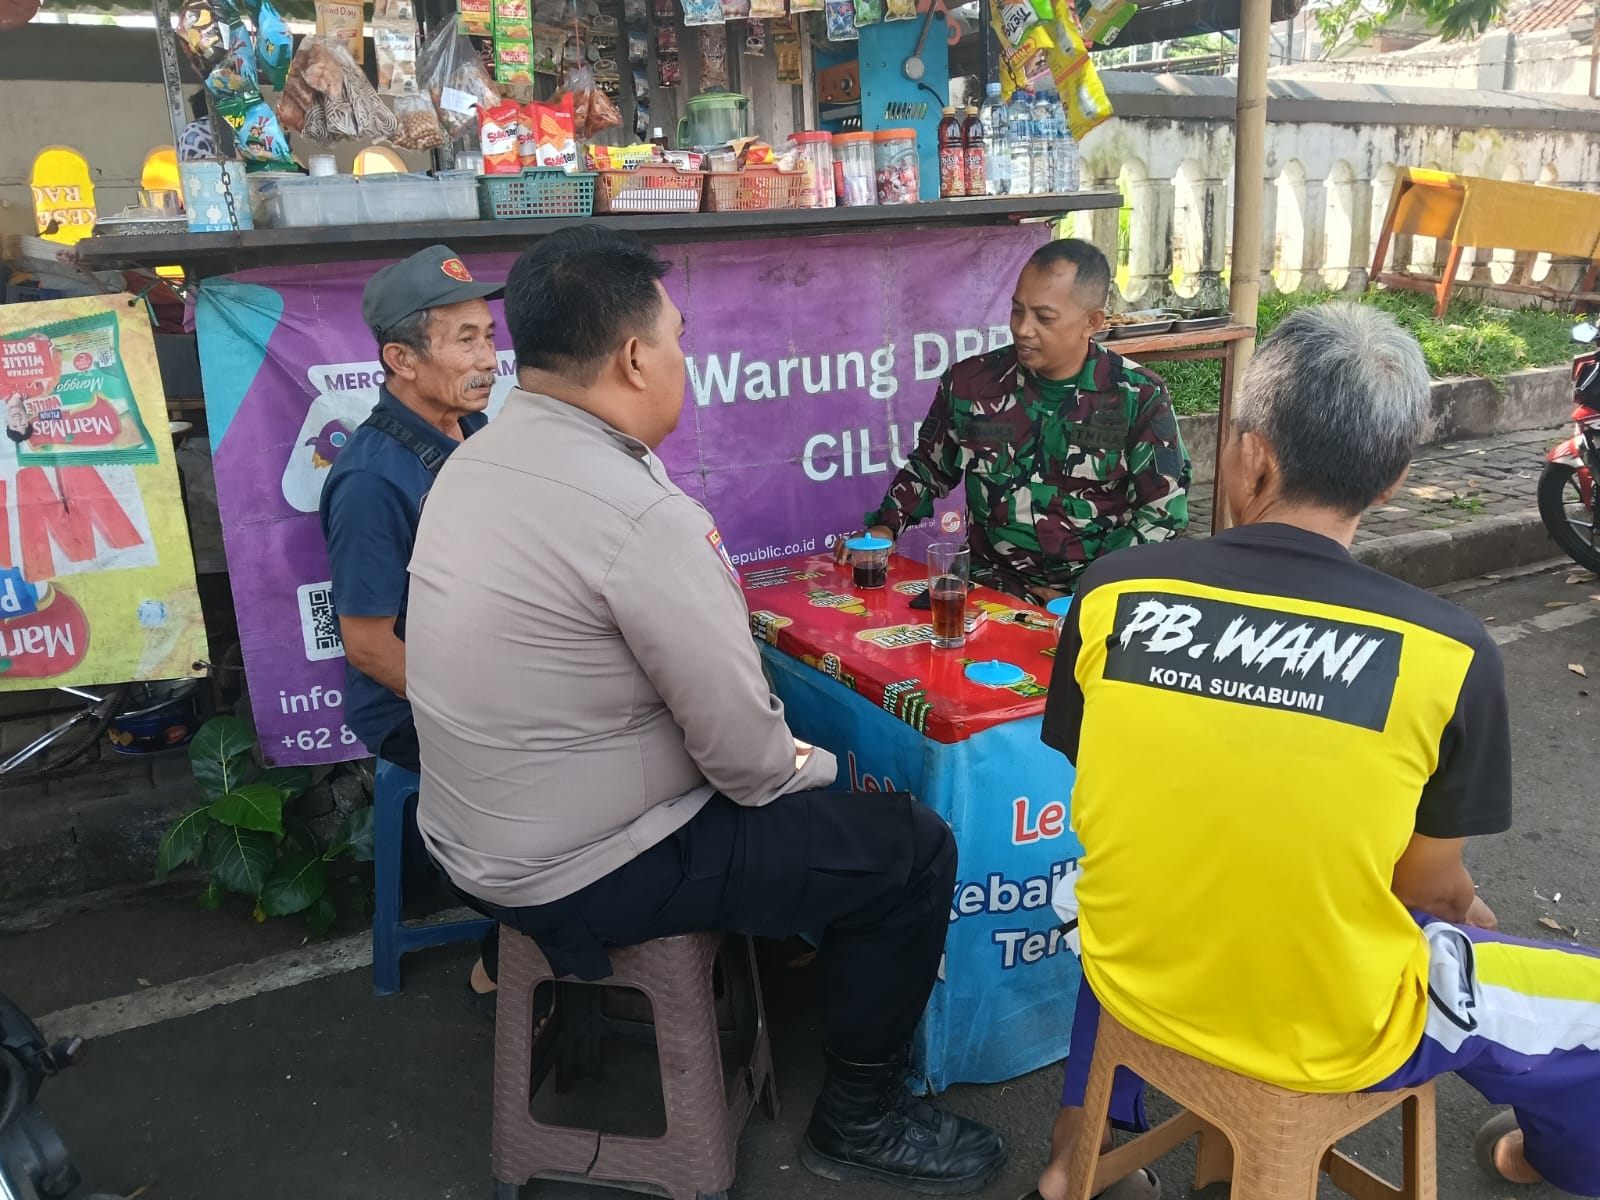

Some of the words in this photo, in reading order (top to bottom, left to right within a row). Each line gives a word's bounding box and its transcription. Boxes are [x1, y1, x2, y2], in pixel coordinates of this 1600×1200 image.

[3, 341, 37, 355] BOX!
[1, 356, 45, 369] WILLIE
[684, 343, 899, 407] Warung
[56, 377, 104, 393] Mangga
[32, 415, 114, 438] MariMas
[802, 421, 922, 482] CILU
[1211, 613, 1385, 689] WANI
[279, 685, 343, 714] info
[1148, 666, 1202, 691] KOTA
[1208, 677, 1324, 712] SUKABUMI
[281, 727, 333, 751] +62
